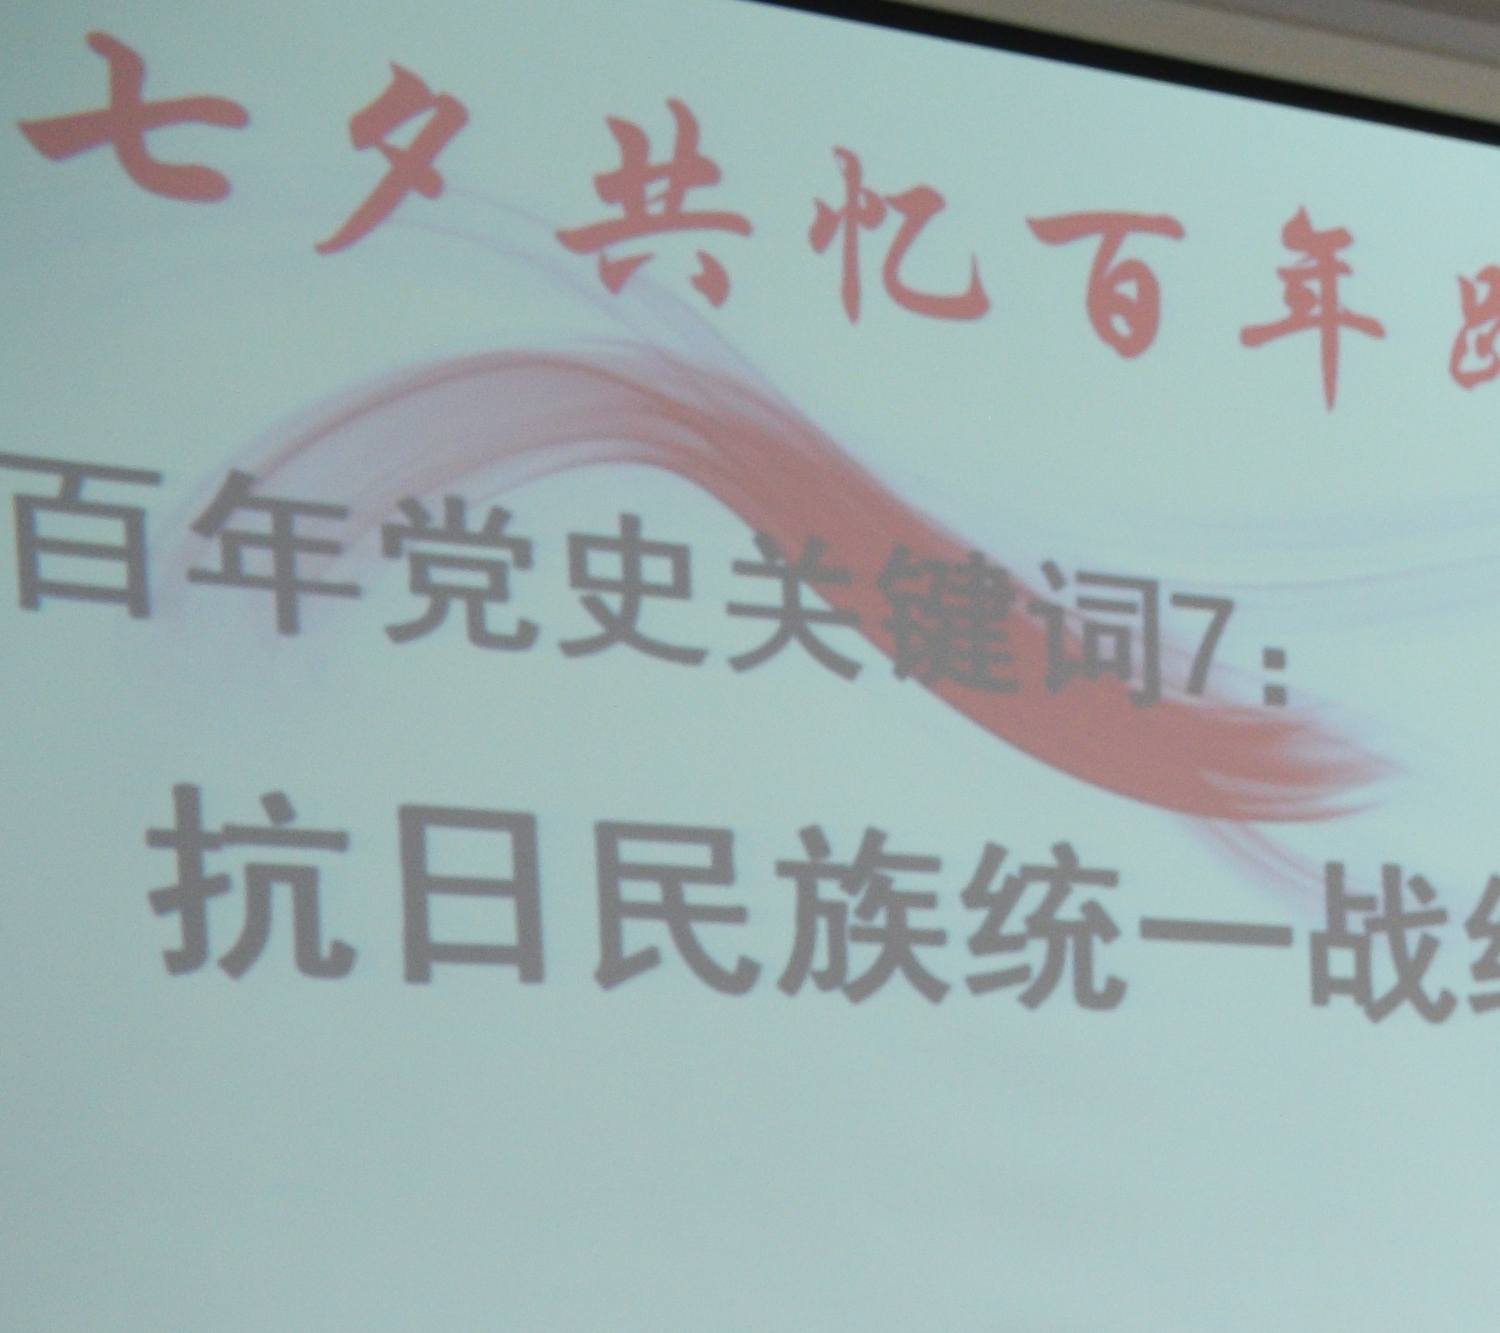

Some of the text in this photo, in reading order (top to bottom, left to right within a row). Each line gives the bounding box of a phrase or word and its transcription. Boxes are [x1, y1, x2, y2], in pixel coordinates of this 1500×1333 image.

[0, 450, 1293, 712] 百年党史关键词7：
